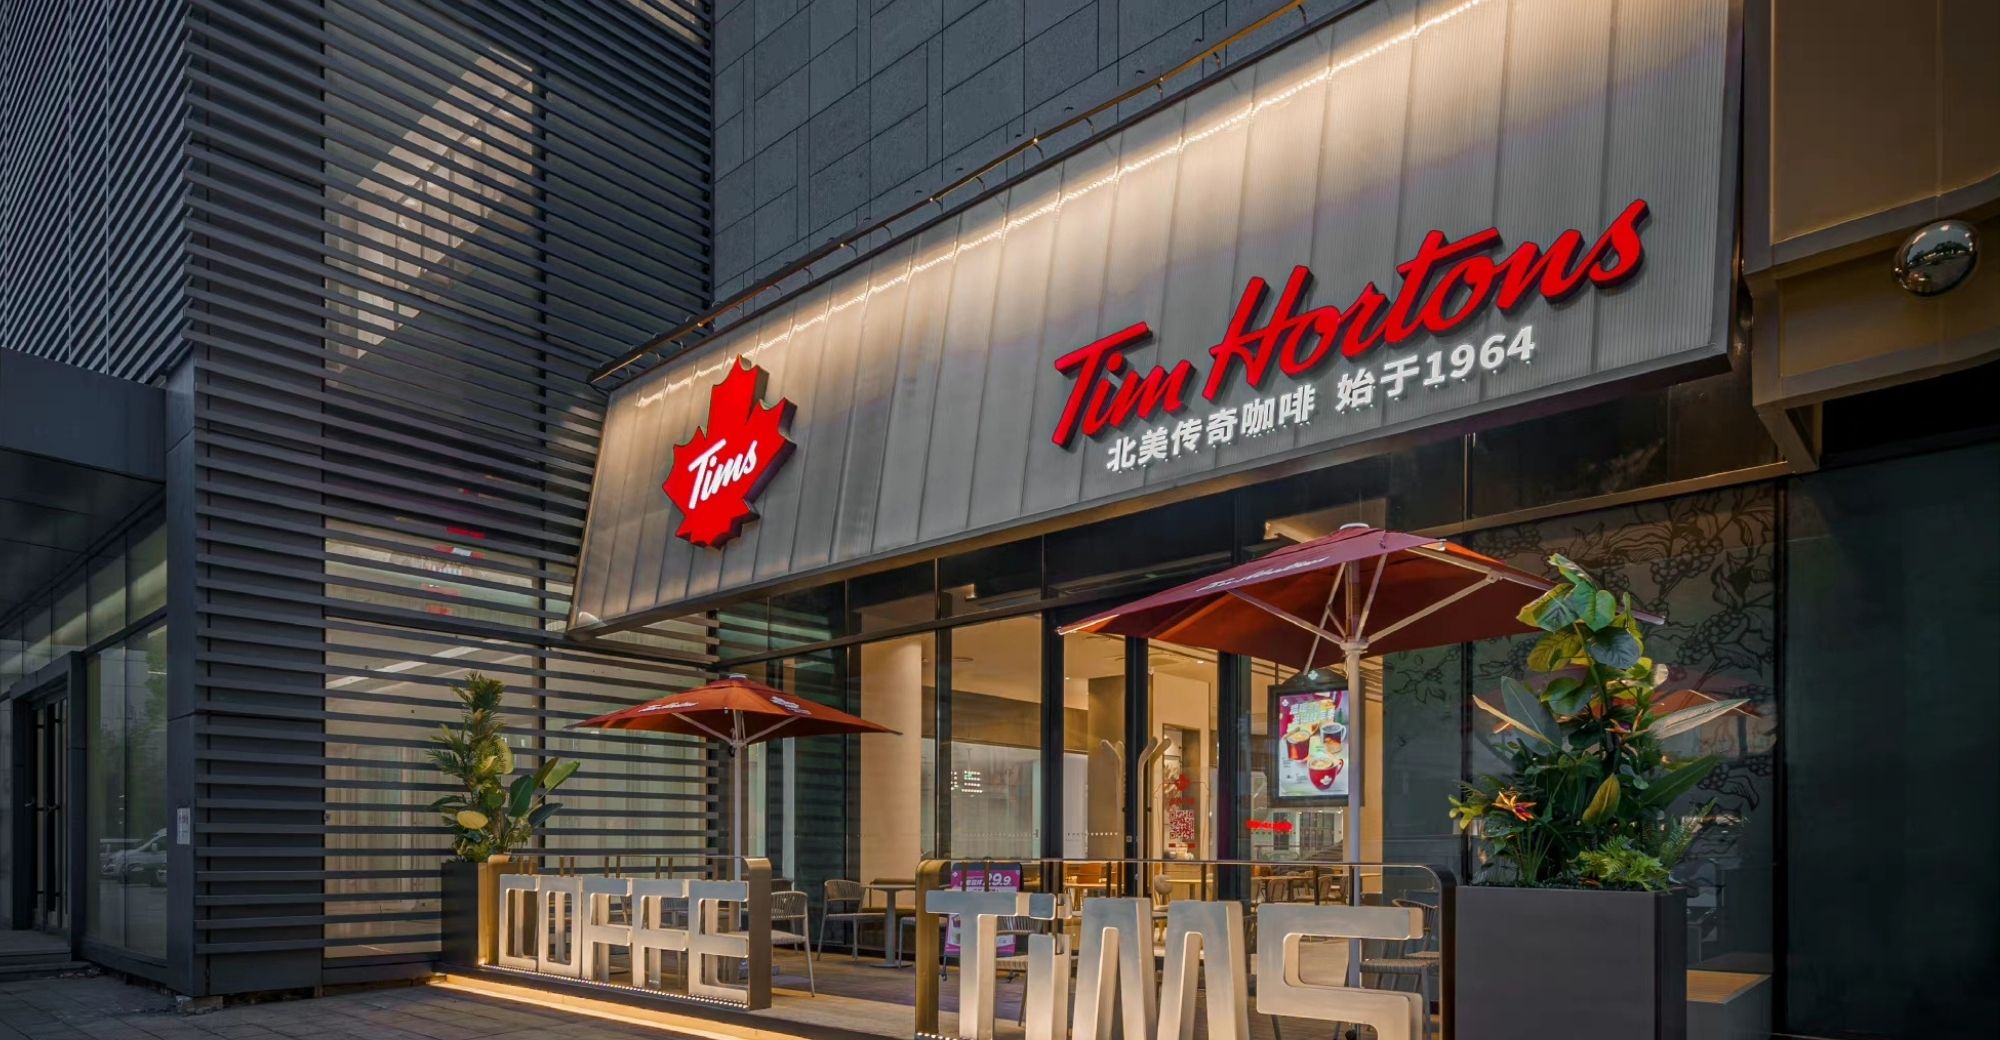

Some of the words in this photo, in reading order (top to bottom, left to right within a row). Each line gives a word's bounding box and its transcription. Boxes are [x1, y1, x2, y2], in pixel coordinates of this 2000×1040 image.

[1052, 320, 1192, 447] Tim
[1201, 198, 1650, 400] Hortons
[1106, 383, 1316, 472] 北美传奇咖啡
[1335, 325, 1535, 411] 始于1964
[688, 438, 758, 510] Tims
